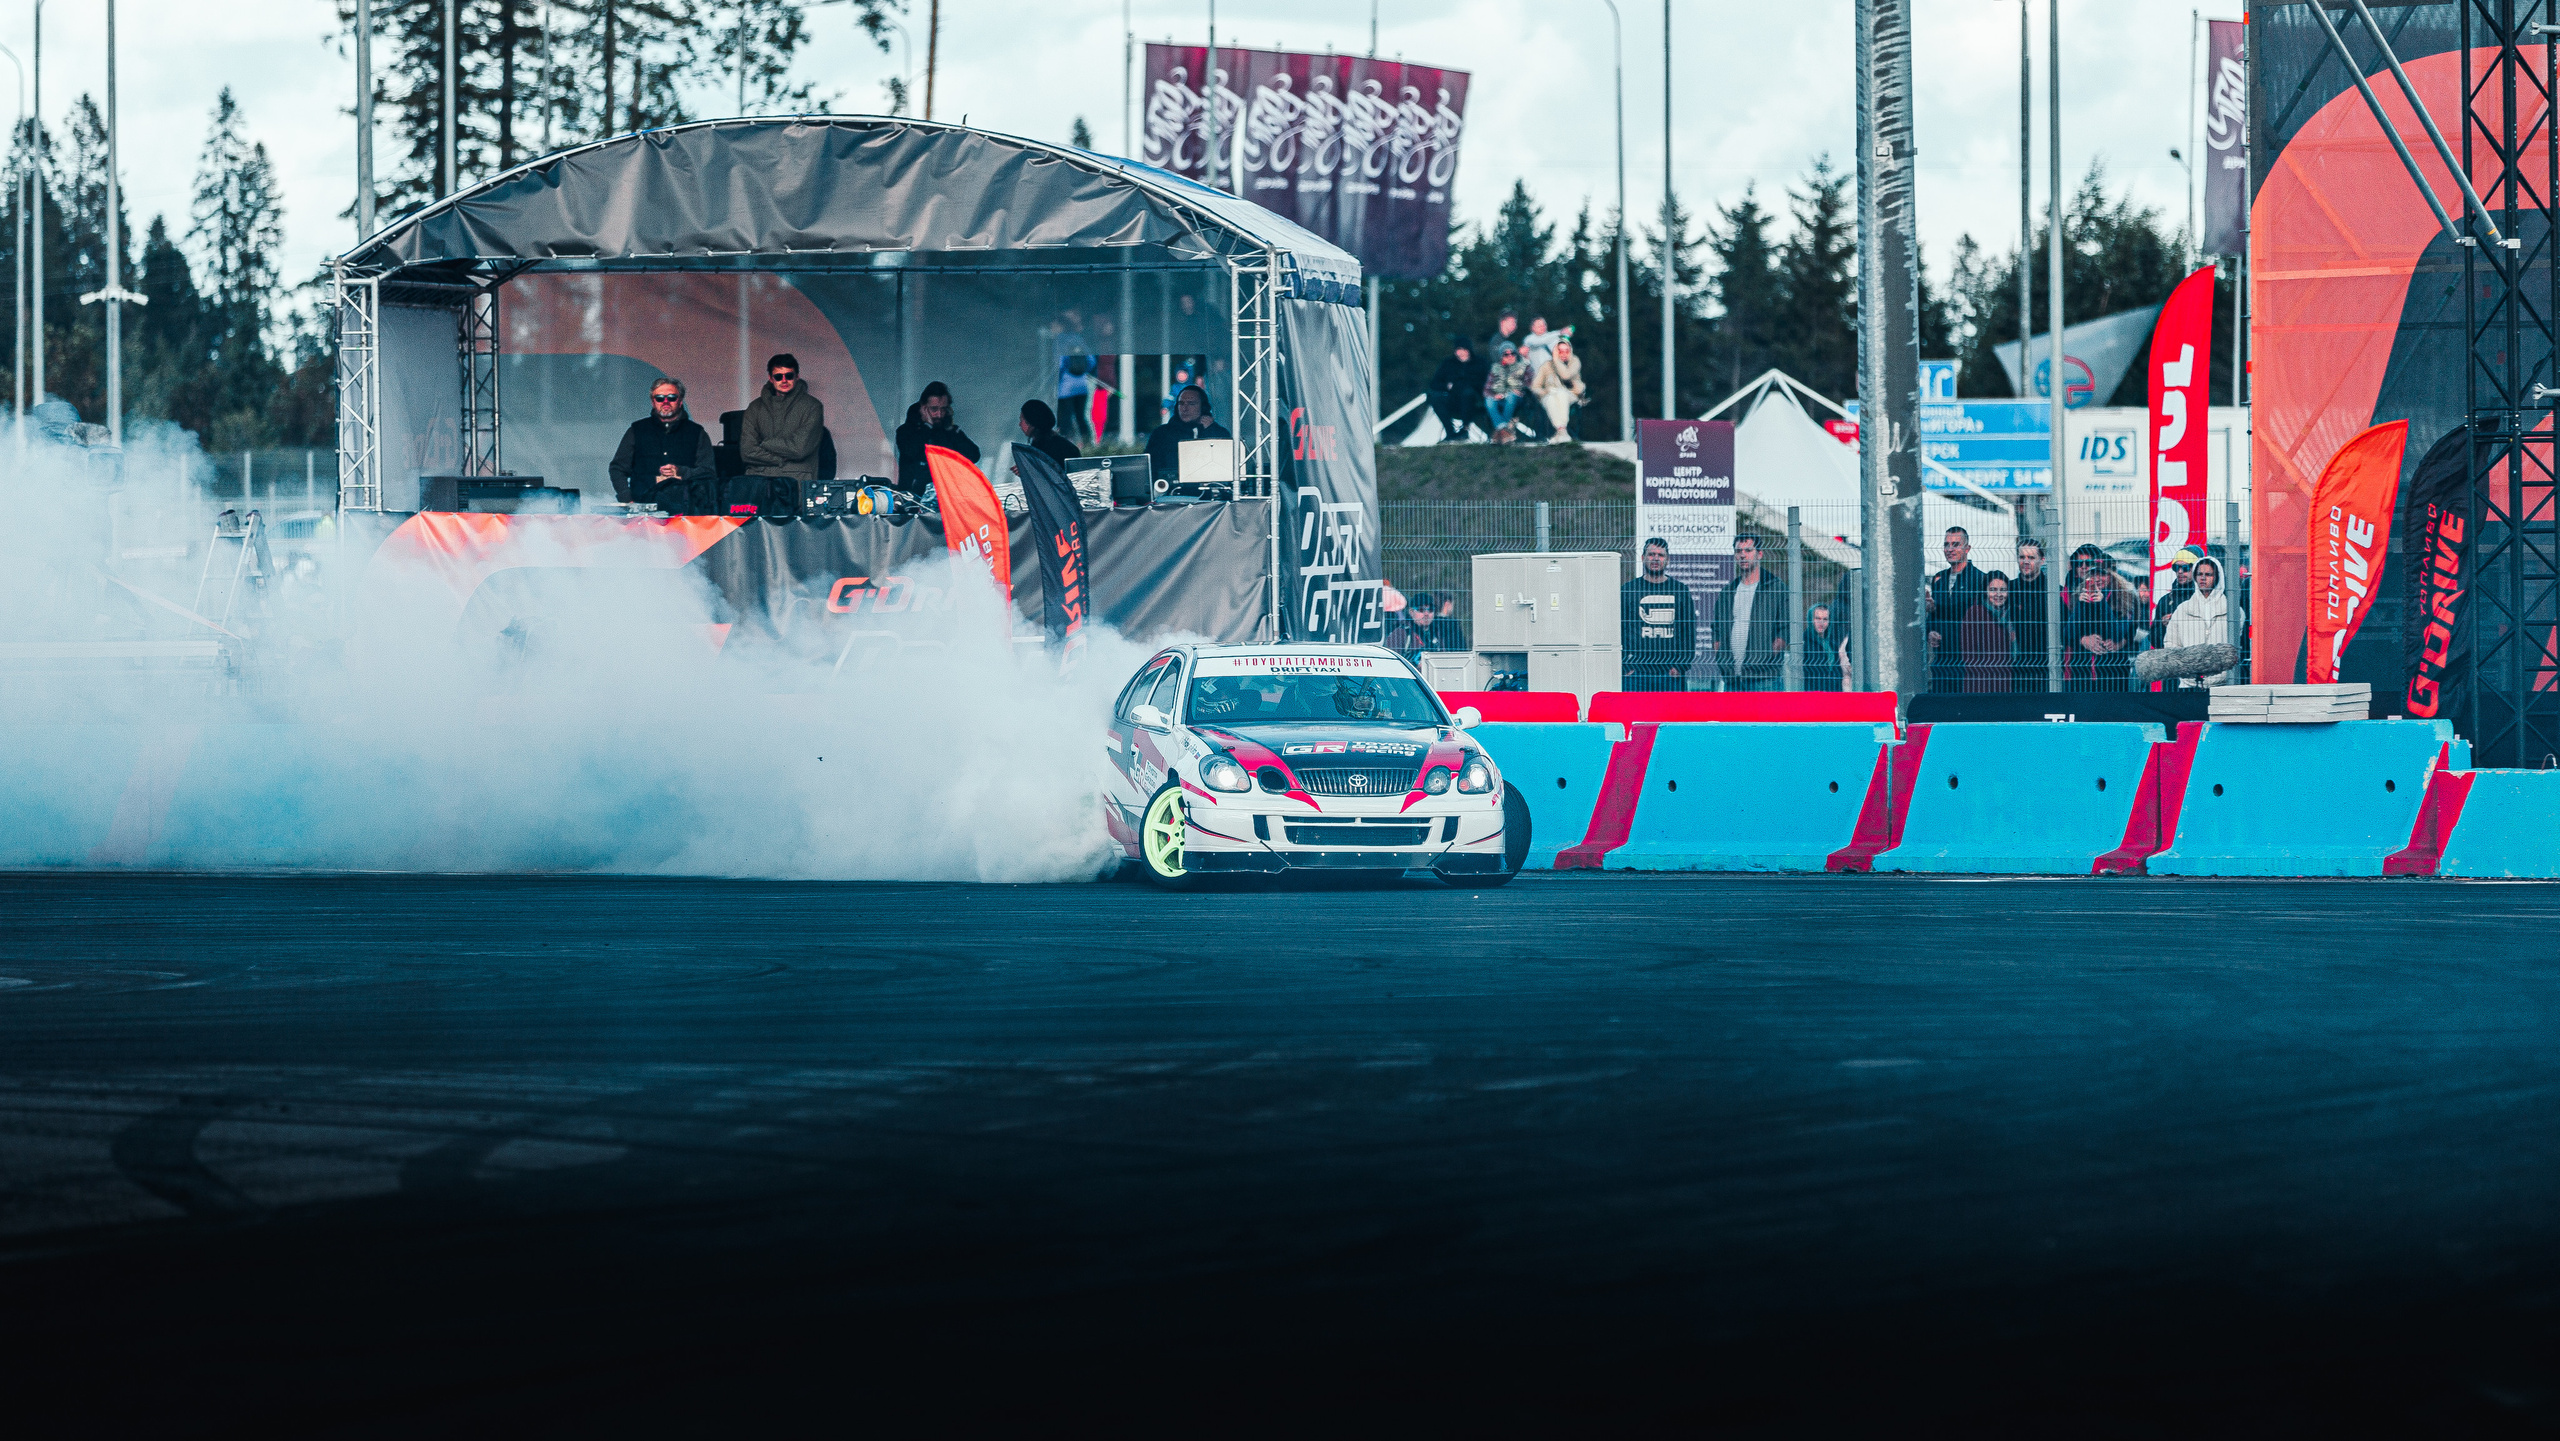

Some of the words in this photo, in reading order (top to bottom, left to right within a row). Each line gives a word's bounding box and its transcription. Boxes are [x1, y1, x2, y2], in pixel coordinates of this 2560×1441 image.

[2080, 436, 2128, 460] IDS
[1673, 466, 1703, 478] ЦЕНТР
[1645, 475, 1730, 489] КОНТРАВАРИЙНОЙ
[1658, 488, 1718, 500] ПОДГОТОВКИ
[1658, 525, 1726, 533] БЕЗОПАСНОСТИ
[2327, 505, 2342, 620] ТОПЛИВО
[2420, 503, 2437, 616] ТОПЛИВО
[1641, 626, 1675, 639] RAW
[1232, 657, 1373, 668] #TOYOTATEAMRUSSIA
[1285, 744, 1345, 754] GR
